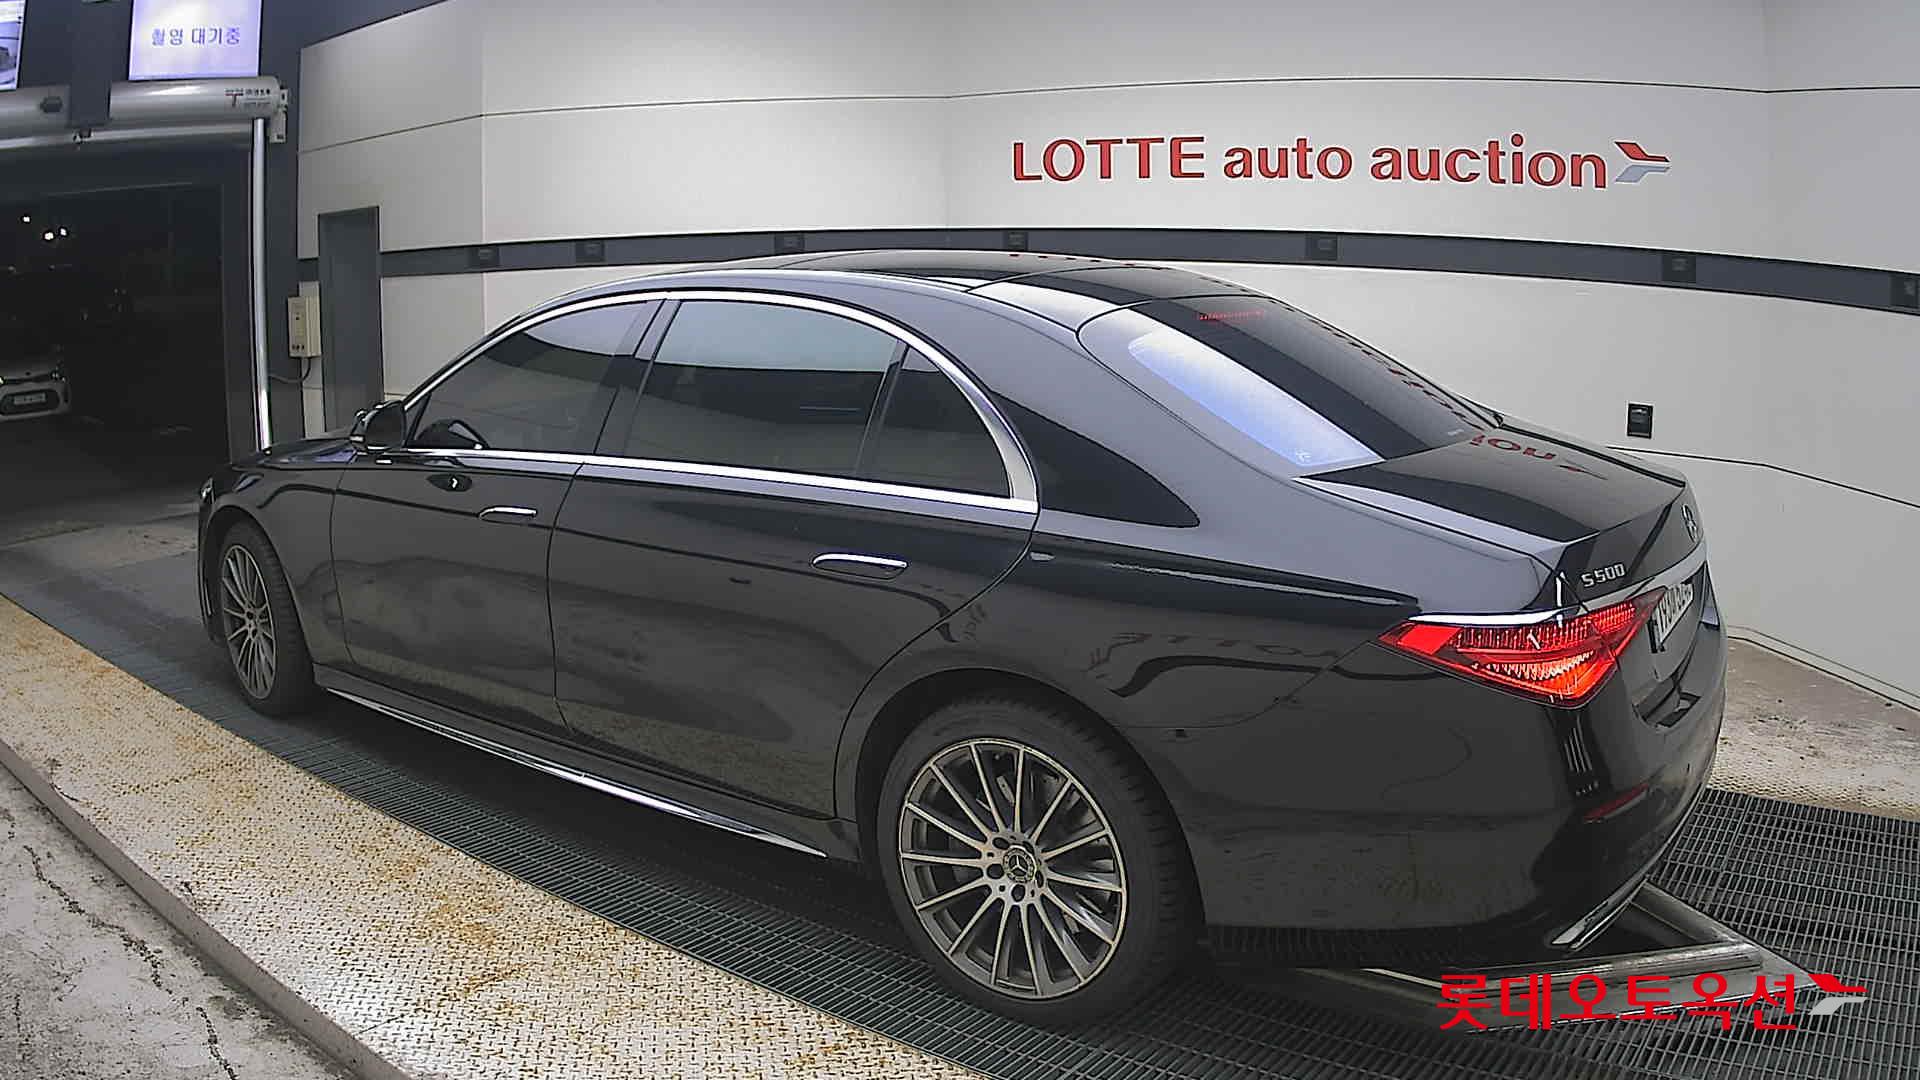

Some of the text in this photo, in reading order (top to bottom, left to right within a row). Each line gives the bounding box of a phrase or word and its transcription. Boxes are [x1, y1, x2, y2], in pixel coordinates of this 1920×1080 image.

[191, 27, 241, 46] 대기중
[1012, 133, 1608, 189] LOTTE auto auction
[1580, 563, 1626, 588] S 500
